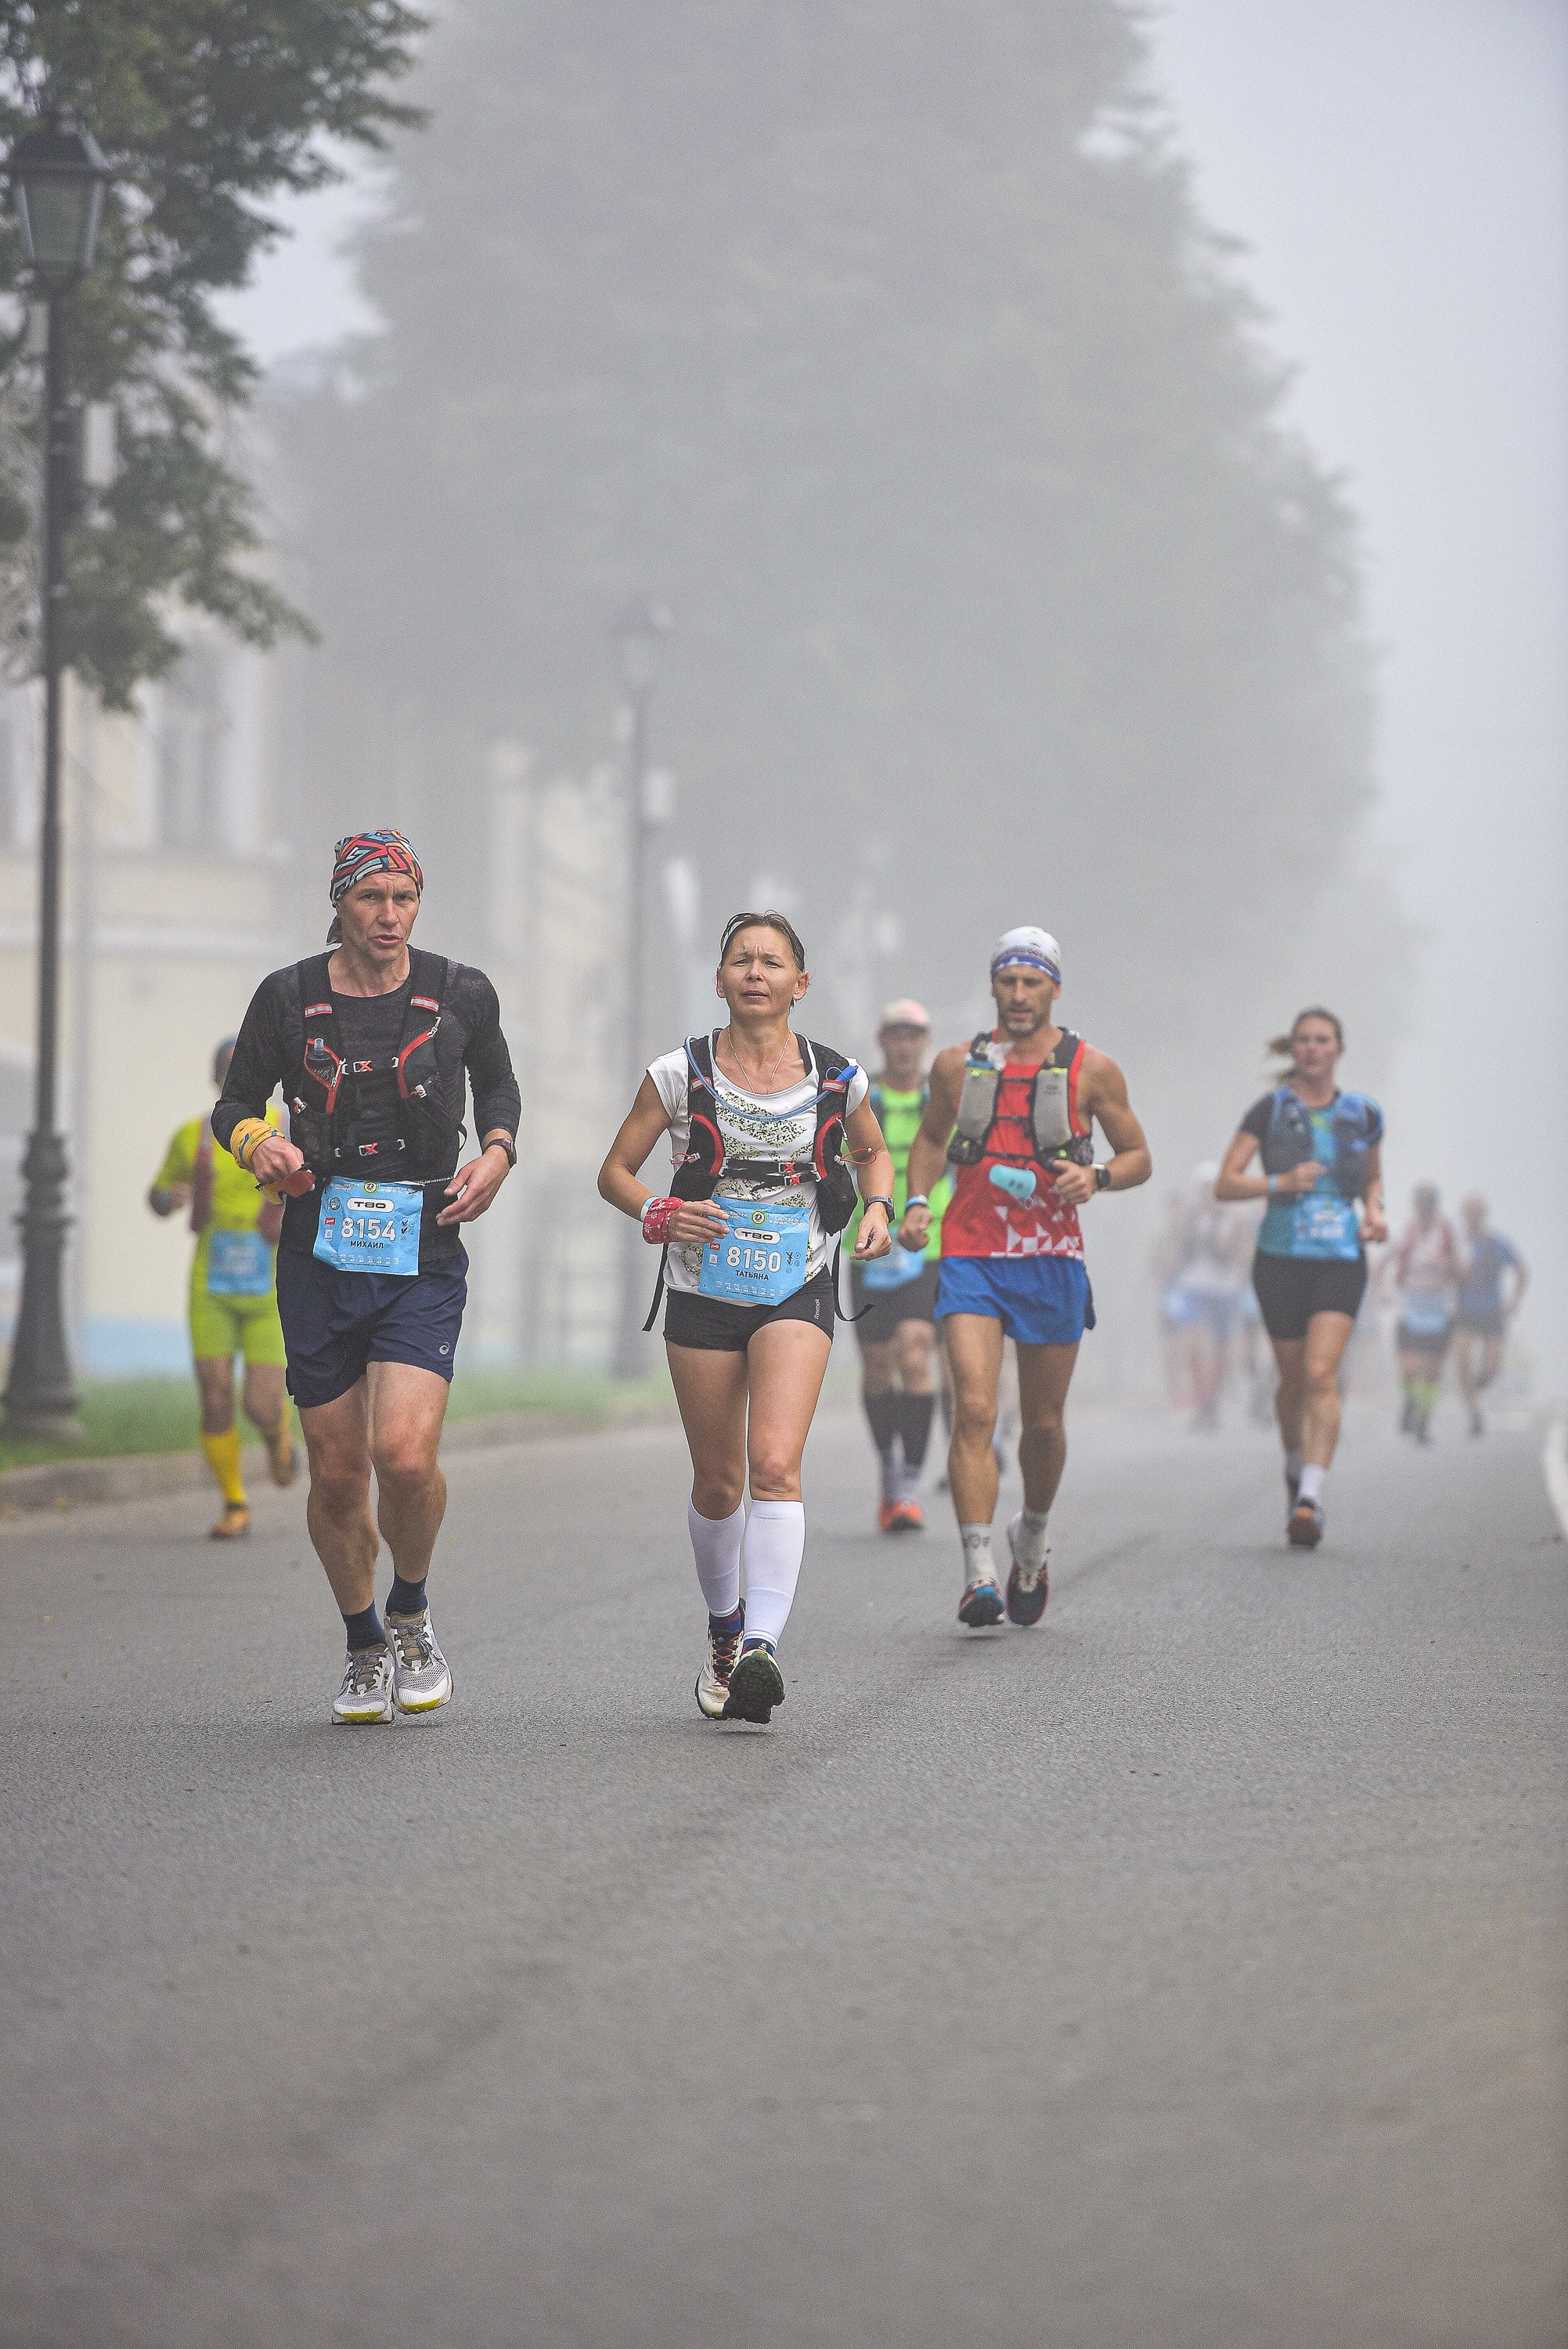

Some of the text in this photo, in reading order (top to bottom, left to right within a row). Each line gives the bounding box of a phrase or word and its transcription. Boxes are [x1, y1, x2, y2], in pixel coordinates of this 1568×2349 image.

[341, 1217, 396, 1241] 8154
[741, 1231, 773, 1240] T80
[350, 1240, 384, 1249] МИХАИЛ
[726, 1245, 782, 1273] 8150
[735, 1270, 770, 1281] ТАТЬЯНА
